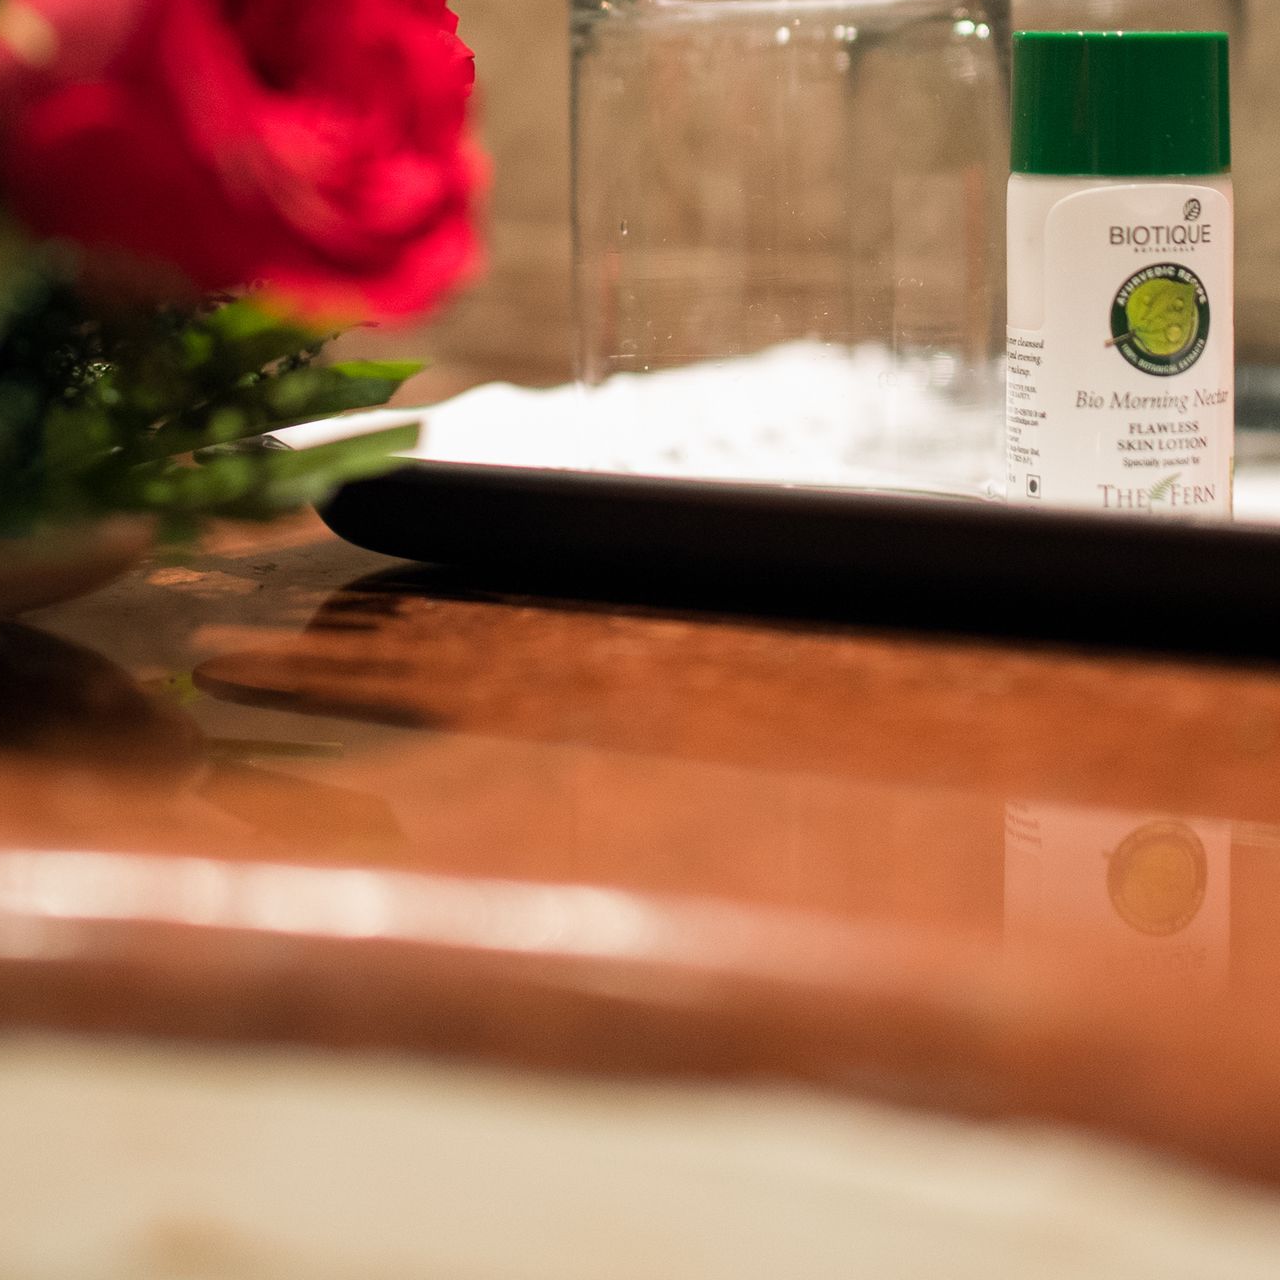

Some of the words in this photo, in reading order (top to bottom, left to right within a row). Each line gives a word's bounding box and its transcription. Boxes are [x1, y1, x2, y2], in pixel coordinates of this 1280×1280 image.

[1109, 224, 1212, 245] BIOTIQUE
[1117, 265, 1176, 307] AYURVEDIC
[1076, 389, 1105, 409] Bio
[1109, 389, 1190, 414] Morning
[1128, 421, 1200, 435] FLAWLESS
[1117, 438, 1155, 452] SKIN
[1157, 436, 1208, 451] LOTION
[1122, 456, 1160, 469] Specially
[1097, 483, 1150, 509] THE
[1171, 483, 1216, 507] FERN
